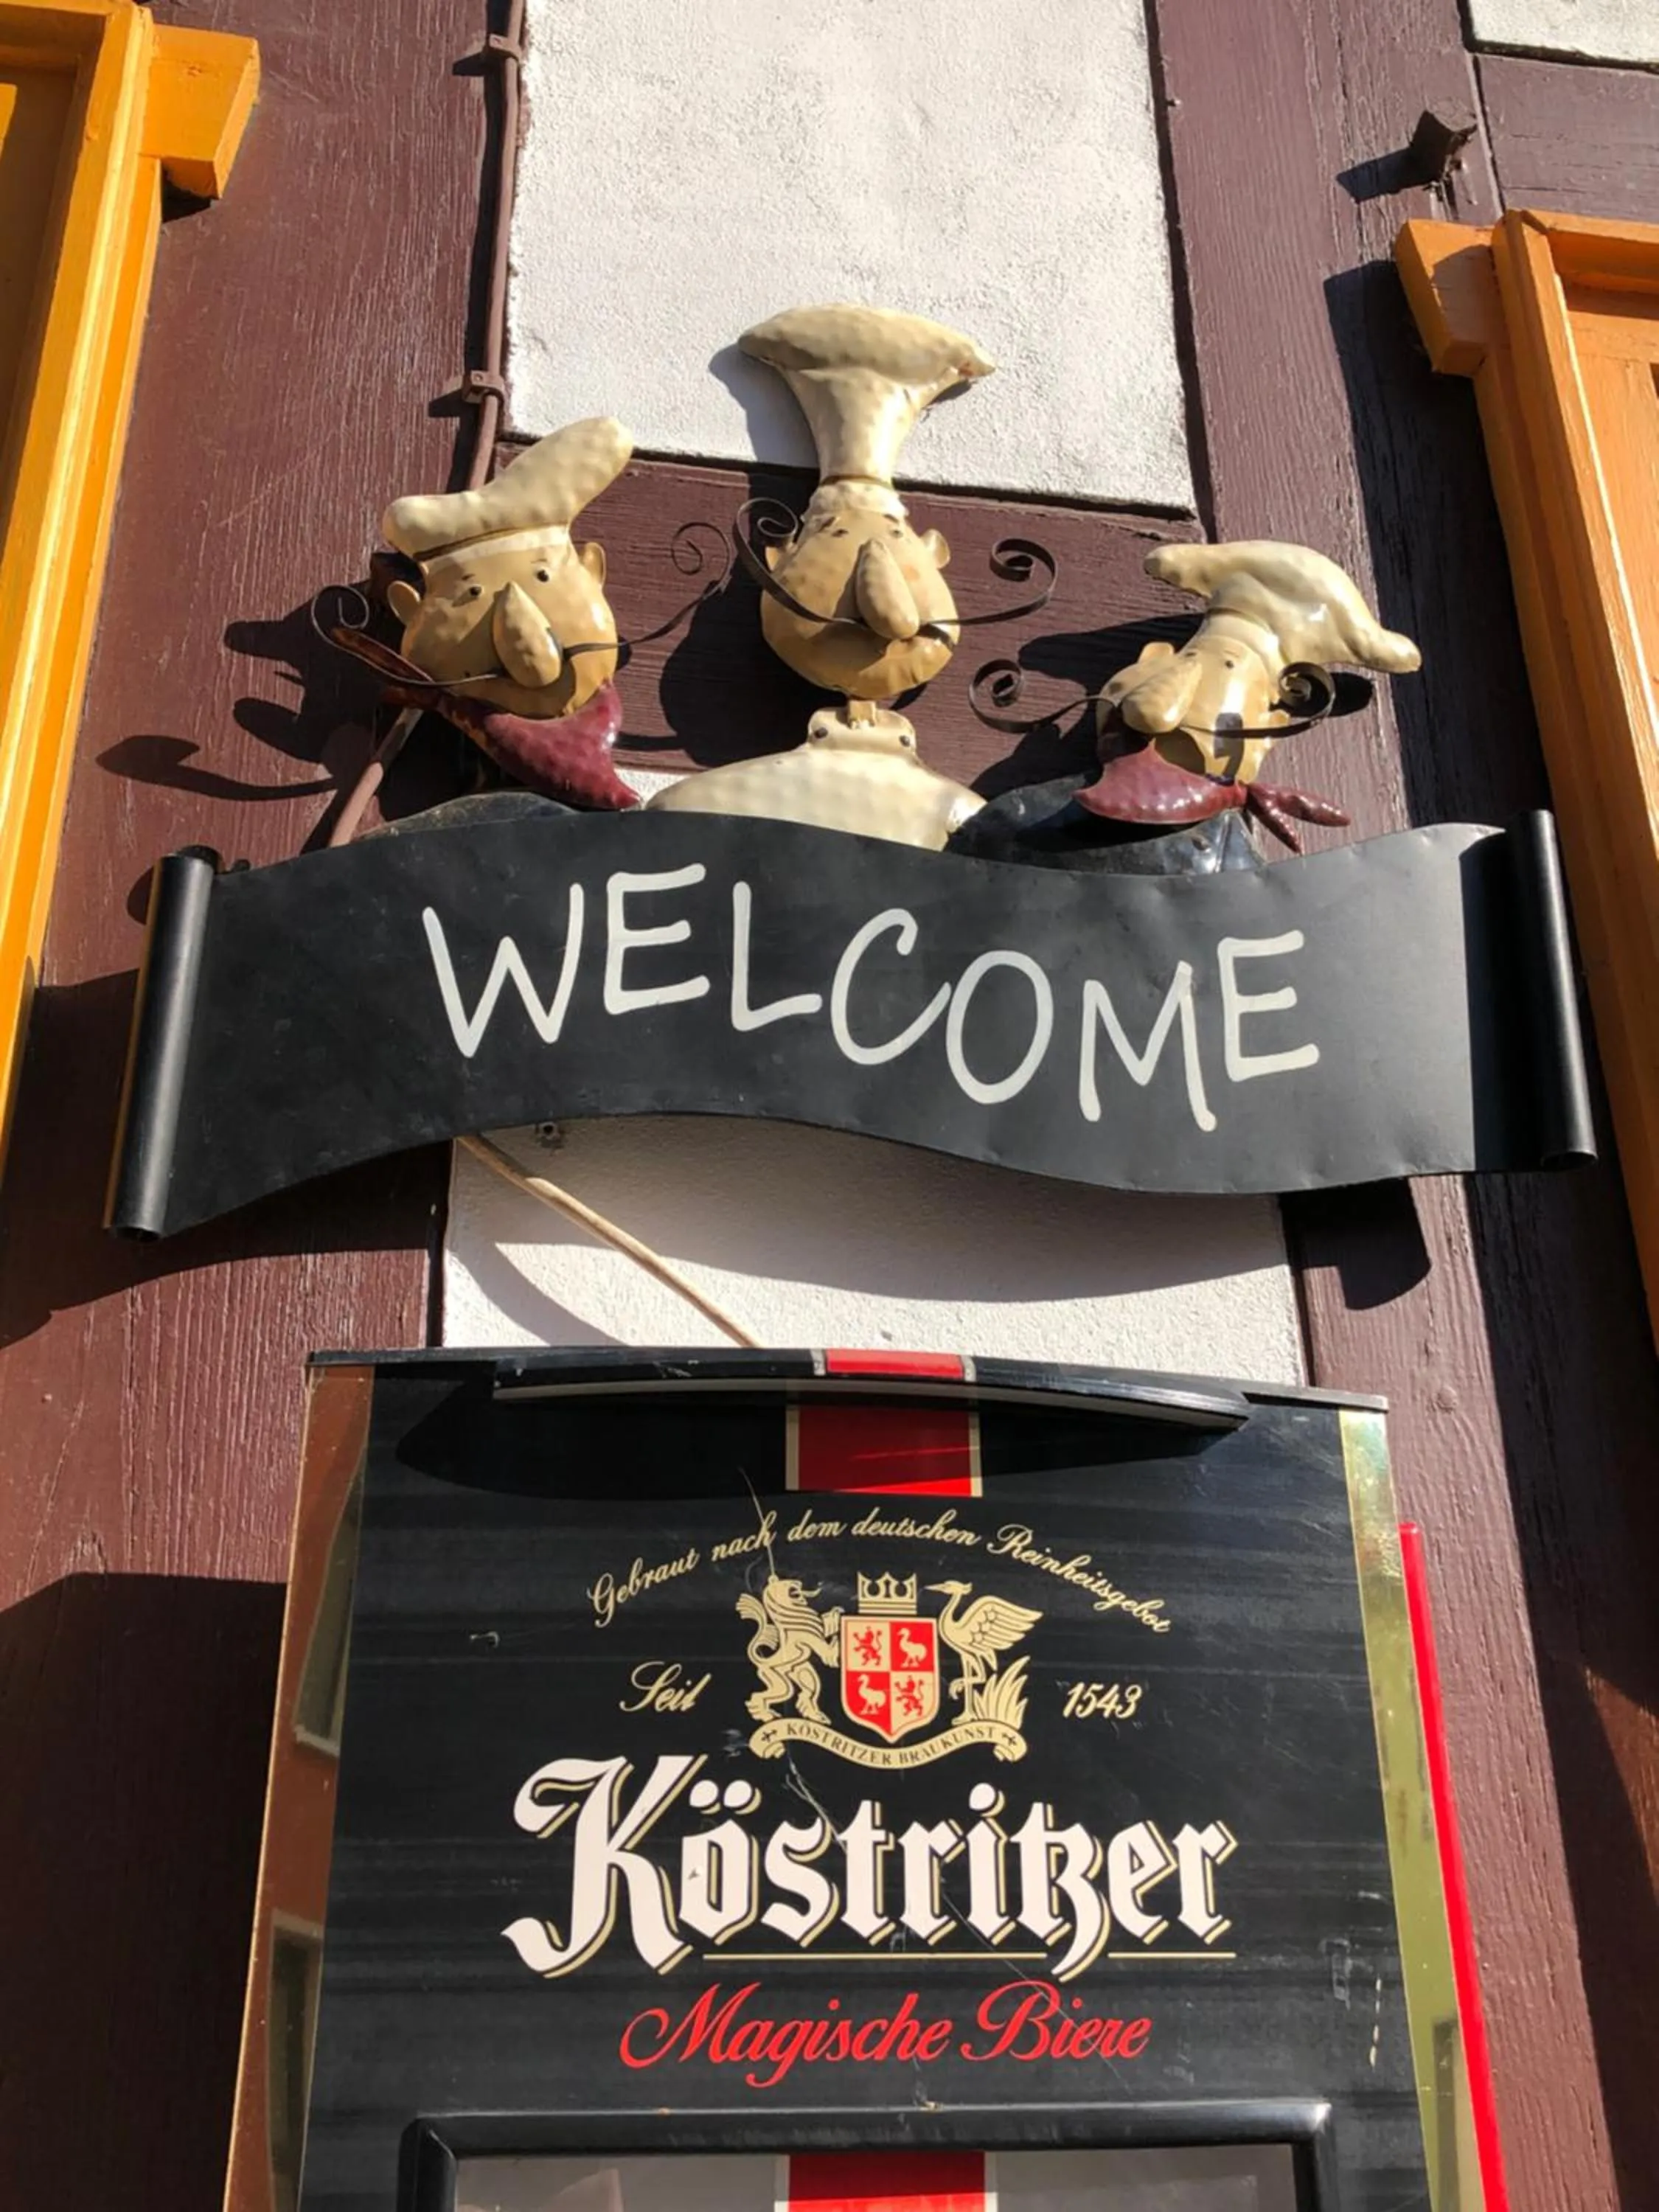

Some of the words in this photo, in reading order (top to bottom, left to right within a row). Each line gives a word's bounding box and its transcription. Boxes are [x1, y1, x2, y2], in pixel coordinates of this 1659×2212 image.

[421, 862, 1321, 1131] WELCOME
[586, 1548, 699, 1628] Gebraut
[712, 1510, 776, 1561] nach
[787, 1509, 846, 1543] dem
[852, 1508, 983, 1545] deutschen
[987, 1524, 1171, 1632] Reinheitsgebot
[619, 1661, 712, 1712] Seit
[1062, 1682, 1142, 1719] 1543
[899, 1727, 998, 1764] BRAUKUNST
[501, 1755, 1237, 1982] Köstritzer
[619, 1982, 952, 2088] Magische
[961, 1980, 1152, 2062] Biere
